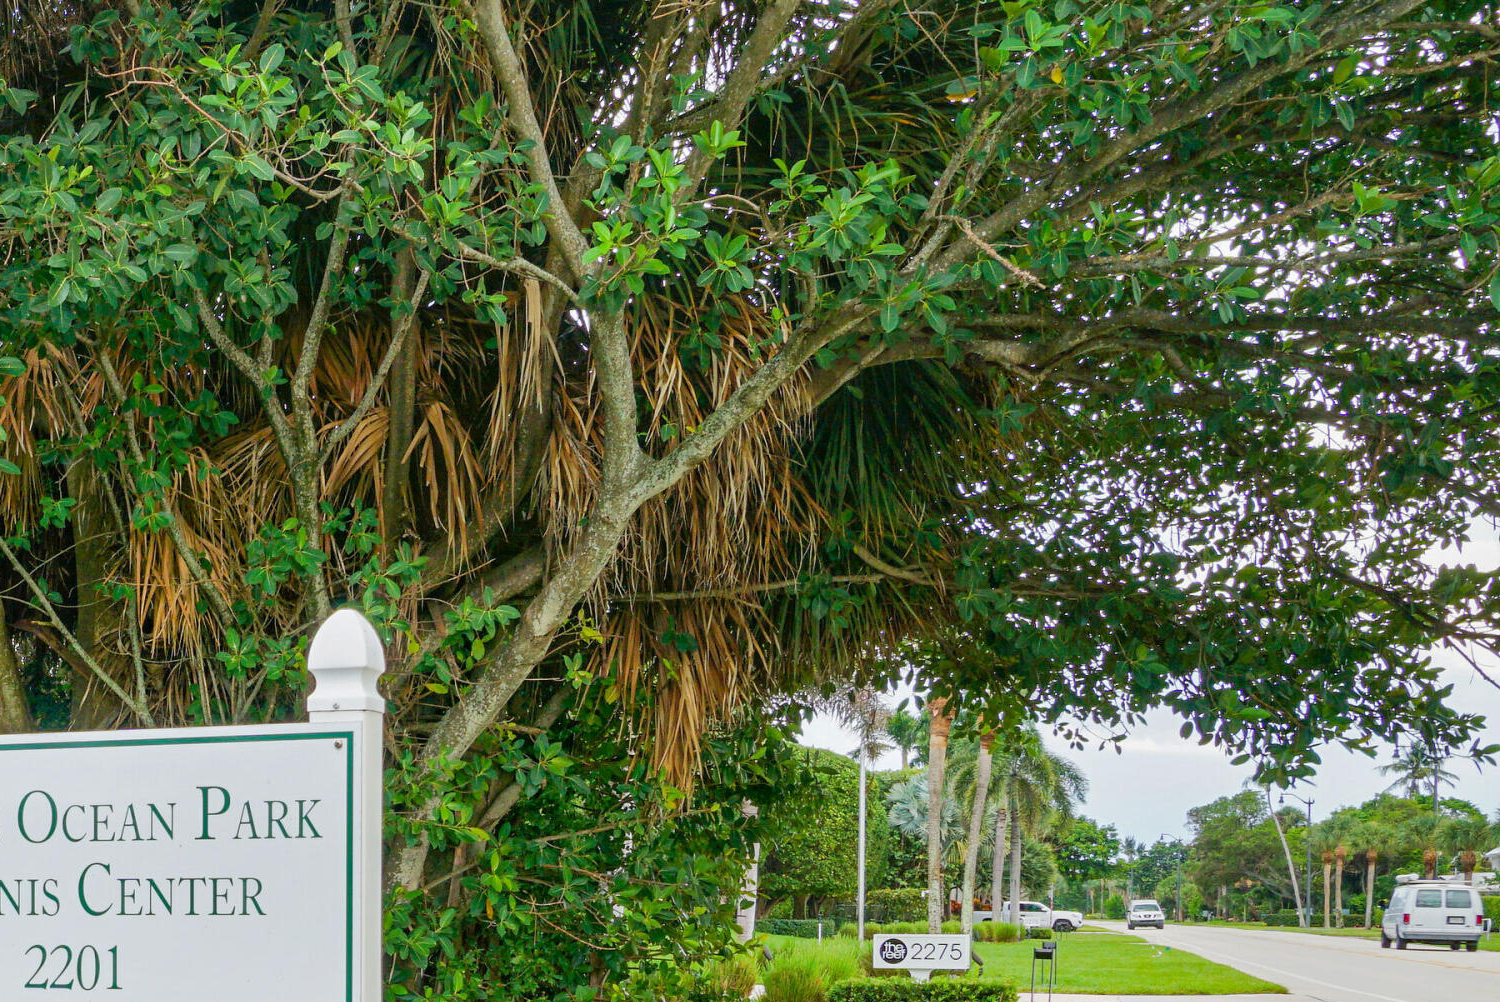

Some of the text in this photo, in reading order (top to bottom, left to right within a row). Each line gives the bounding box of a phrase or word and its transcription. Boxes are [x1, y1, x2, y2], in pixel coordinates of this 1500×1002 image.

[17, 789, 177, 844] OCEAN
[194, 785, 323, 841] PARK
[77, 862, 268, 917] CENTER
[882, 950, 906, 960] reef
[884, 942, 903, 951] the
[910, 943, 963, 961] 2275
[24, 944, 124, 991] 2201
